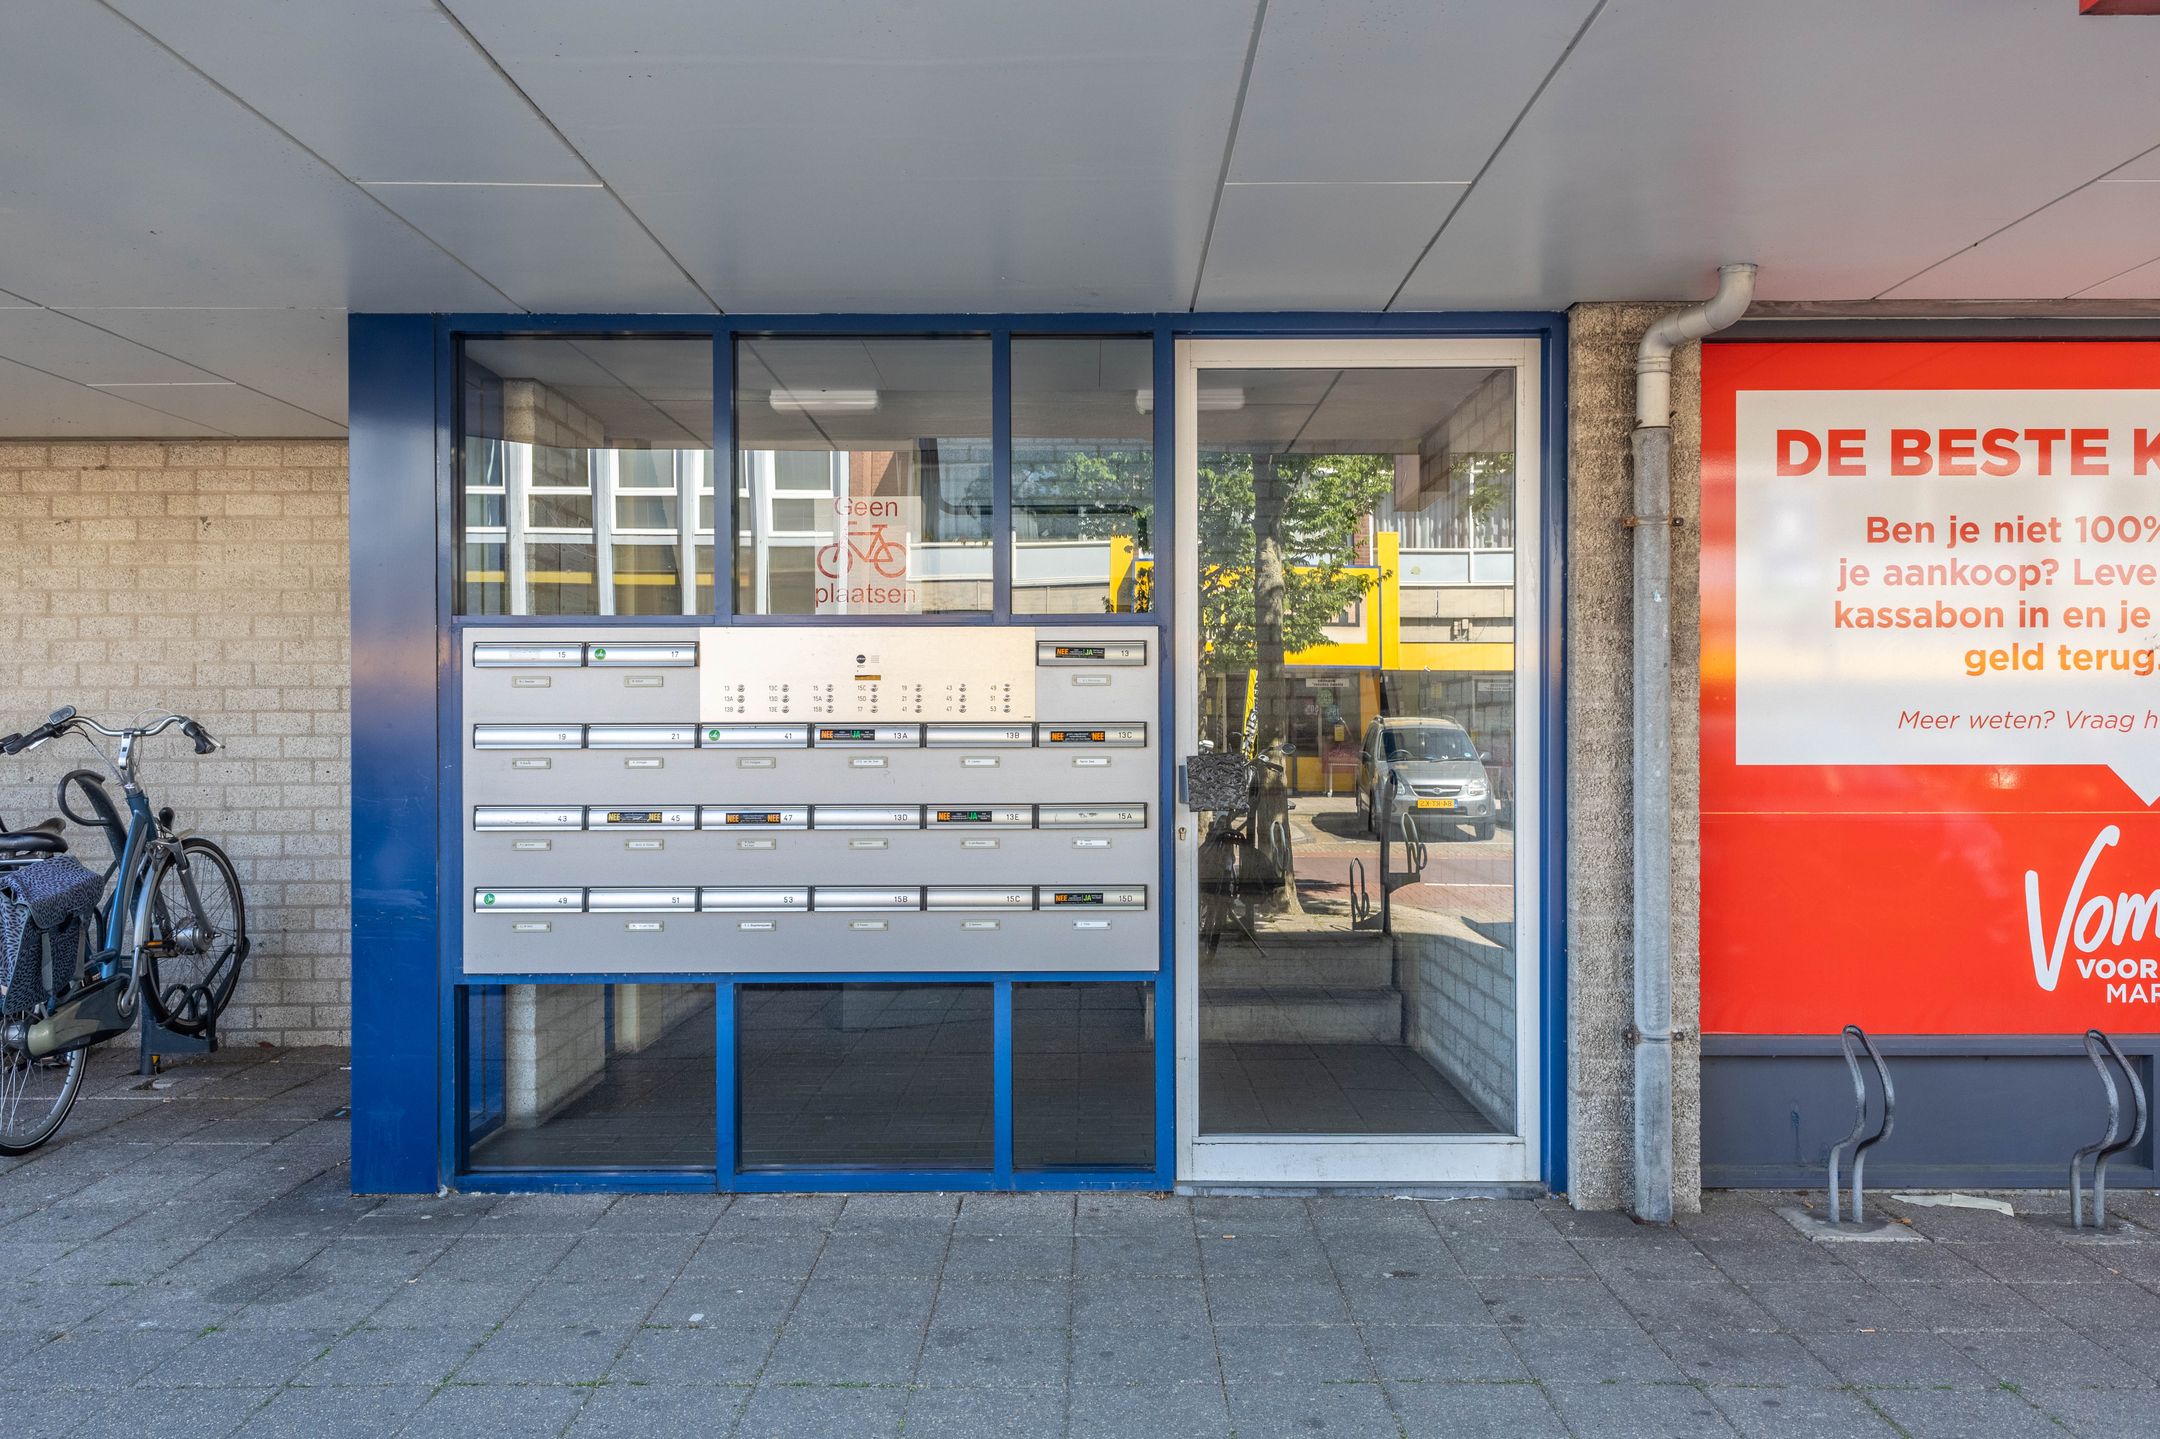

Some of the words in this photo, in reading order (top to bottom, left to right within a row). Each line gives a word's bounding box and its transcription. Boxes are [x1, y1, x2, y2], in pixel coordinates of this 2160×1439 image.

[1776, 429, 1867, 476] DE
[1891, 428, 2109, 477] BESTE
[834, 496, 898, 516] Geen
[1866, 516, 1935, 543] Ben
[1947, 515, 1980, 548] je
[1994, 515, 2062, 543] niet
[2075, 516, 2160, 543] 100%
[1837, 558, 1870, 591] je
[1883, 558, 2060, 591] aankoop?
[2073, 559, 2156, 586] Leve
[816, 583, 916, 607] plaatsen
[1835, 601, 2004, 628] kassabon
[2018, 601, 2049, 628] in
[2063, 607, 2106, 628] en
[2118, 601, 2150, 633] je
[1056, 648, 1069, 656] NEE
[1964, 643, 2044, 676] geld
[1898, 710, 1960, 730] Meer
[1969, 710, 2055, 730] weten?
[2066, 710, 2135, 733] Vraag
[2144, 710, 2159, 729] h
[821, 731, 833, 739] NEE
[851, 731, 861, 739] JA
[1051, 732, 1065, 741] NEE
[1092, 732, 1105, 741] NEE
[608, 813, 621, 821] NEE
[649, 813, 662, 821] NEE
[727, 814, 739, 823] NEE
[767, 813, 780, 822] NEE
[938, 812, 951, 820] NEE
[968, 812, 978, 820] JA
[1006, 895, 1021, 903] 15C
[1055, 894, 1068, 902] NEE
[1083, 894, 1092, 902] JA
[2024, 825, 2160, 992] Vom
[2076, 958, 2158, 979] VOOR
